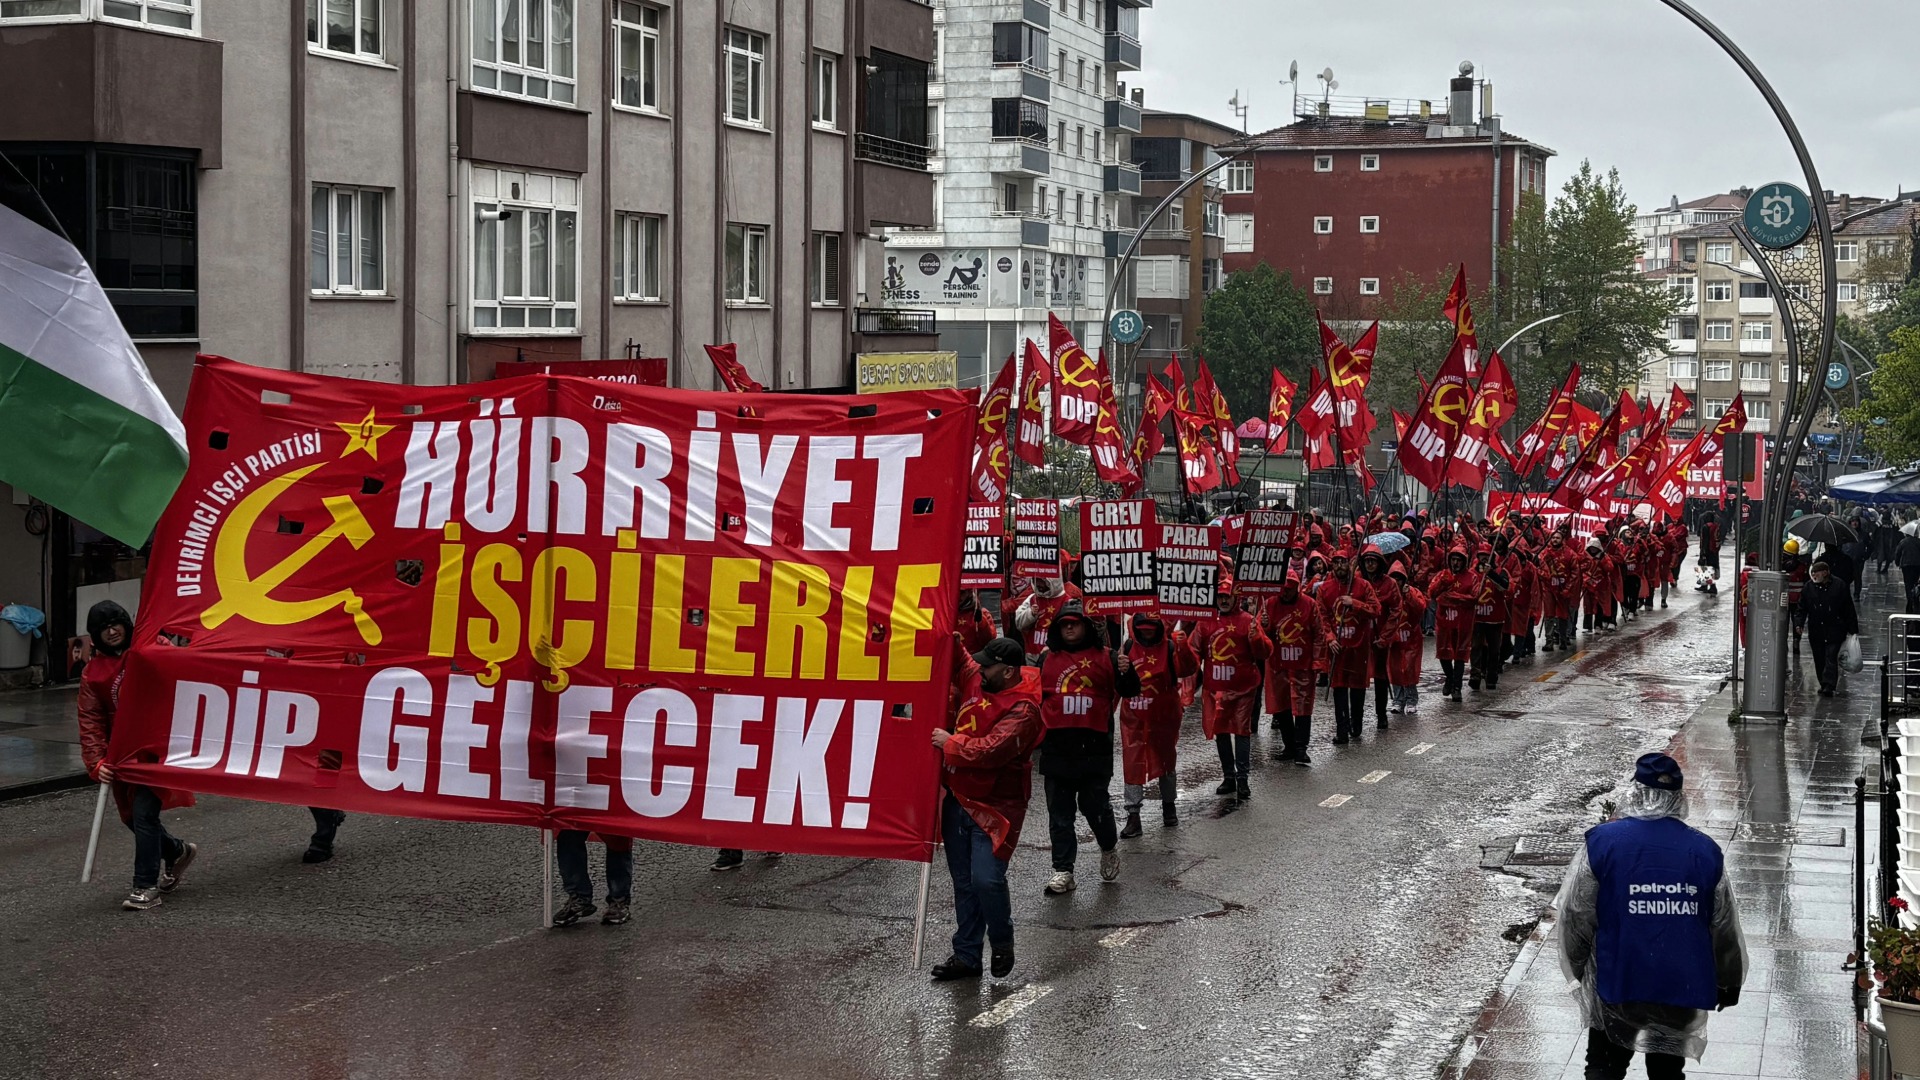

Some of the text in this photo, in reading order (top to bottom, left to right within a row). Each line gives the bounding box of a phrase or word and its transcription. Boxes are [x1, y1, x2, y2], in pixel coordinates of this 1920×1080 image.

[1752, 225, 1803, 244] BÜYÜKŞEHİR
[943, 283, 981, 291] PERSONEL
[943, 291, 978, 299] TRAINING
[861, 363, 897, 385] BERAT
[899, 361, 926, 384] SPOR
[1061, 394, 1099, 424] DİP
[1021, 418, 1042, 448] DİP
[1410, 421, 1446, 462] DİP
[394, 397, 923, 552] HÜRRİYET
[979, 469, 1000, 502] DİP
[1659, 479, 1684, 507] DİP
[177, 428, 322, 597] DEVRİMCİ İŞÇİ PARTİSİ
[1016, 500, 1057, 518] İŞSİZE İŞ
[1090, 501, 1143, 526] GREV
[966, 519, 990, 533] ARIŞ
[1016, 520, 1057, 533] HERKESE AŞ
[1250, 511, 1293, 527] YAŞASIN
[1091, 528, 1143, 551] HAKKI
[1162, 525, 1209, 547] PARA
[1246, 528, 1290, 544] 1 MAYIS
[1016, 545, 1058, 560] HÜRRİYET
[1265, 548, 1286, 562] YEK
[962, 554, 998, 572] AVAŞ
[1083, 552, 1153, 577] GREVLE
[1084, 576, 1153, 593] SAVUNULUR
[428, 521, 942, 692] İŞÇİLERLE
[1281, 645, 1303, 661] DİP
[1212, 663, 1236, 681] DİP
[1063, 693, 1093, 715] DİP
[164, 666, 884, 829] DİP GELECEK!
[1629, 882, 1698, 896] petrol-iş
[1628, 898, 1699, 915] SENDİKASI
